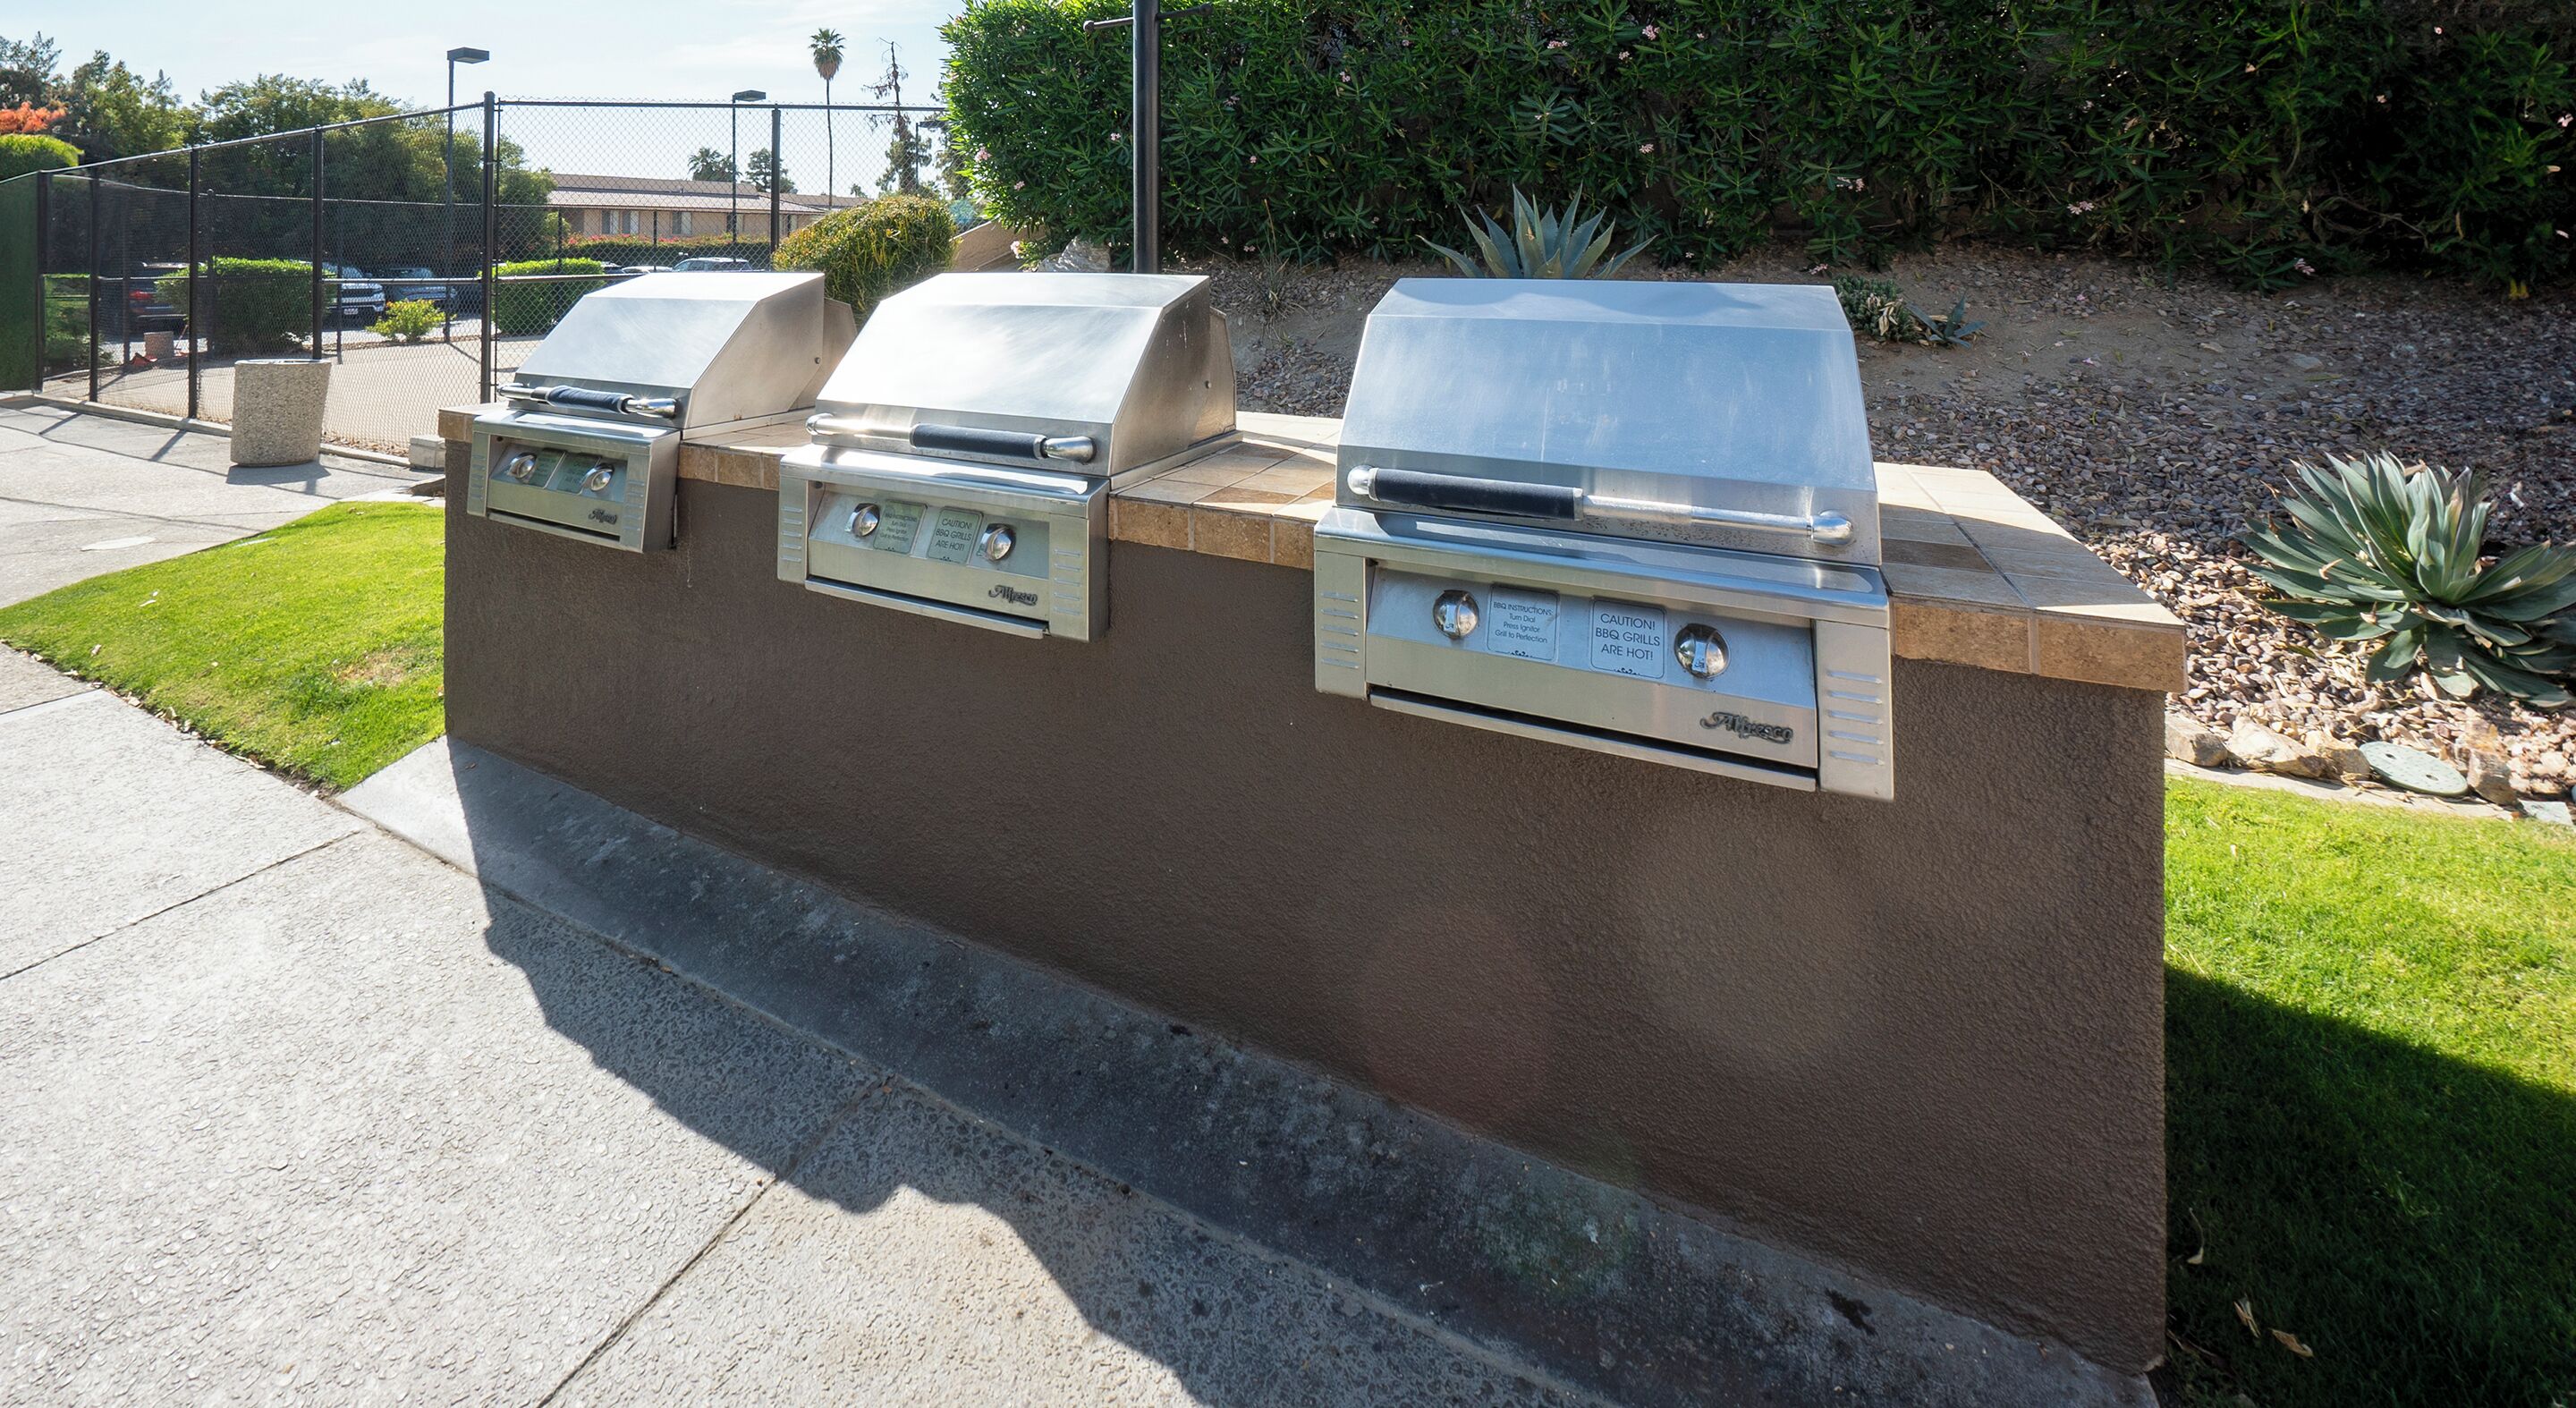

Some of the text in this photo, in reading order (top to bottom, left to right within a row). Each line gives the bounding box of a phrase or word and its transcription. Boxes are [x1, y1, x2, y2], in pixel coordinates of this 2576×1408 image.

[942, 519, 972, 530] CAUTION!
[1493, 601, 1507, 609] BBQ
[1509, 613, 1536, 623] Turn Dial
[1600, 613, 1656, 631] CAUTION!
[1504, 621, 1519, 630] Press
[1495, 629, 1507, 637] Grill
[1515, 632, 1547, 643] Perfection
[1595, 627, 1660, 647] BBQ GRILLS
[1600, 643, 1654, 661] ARE HOT!
[1699, 711, 1793, 744] Alfresco
